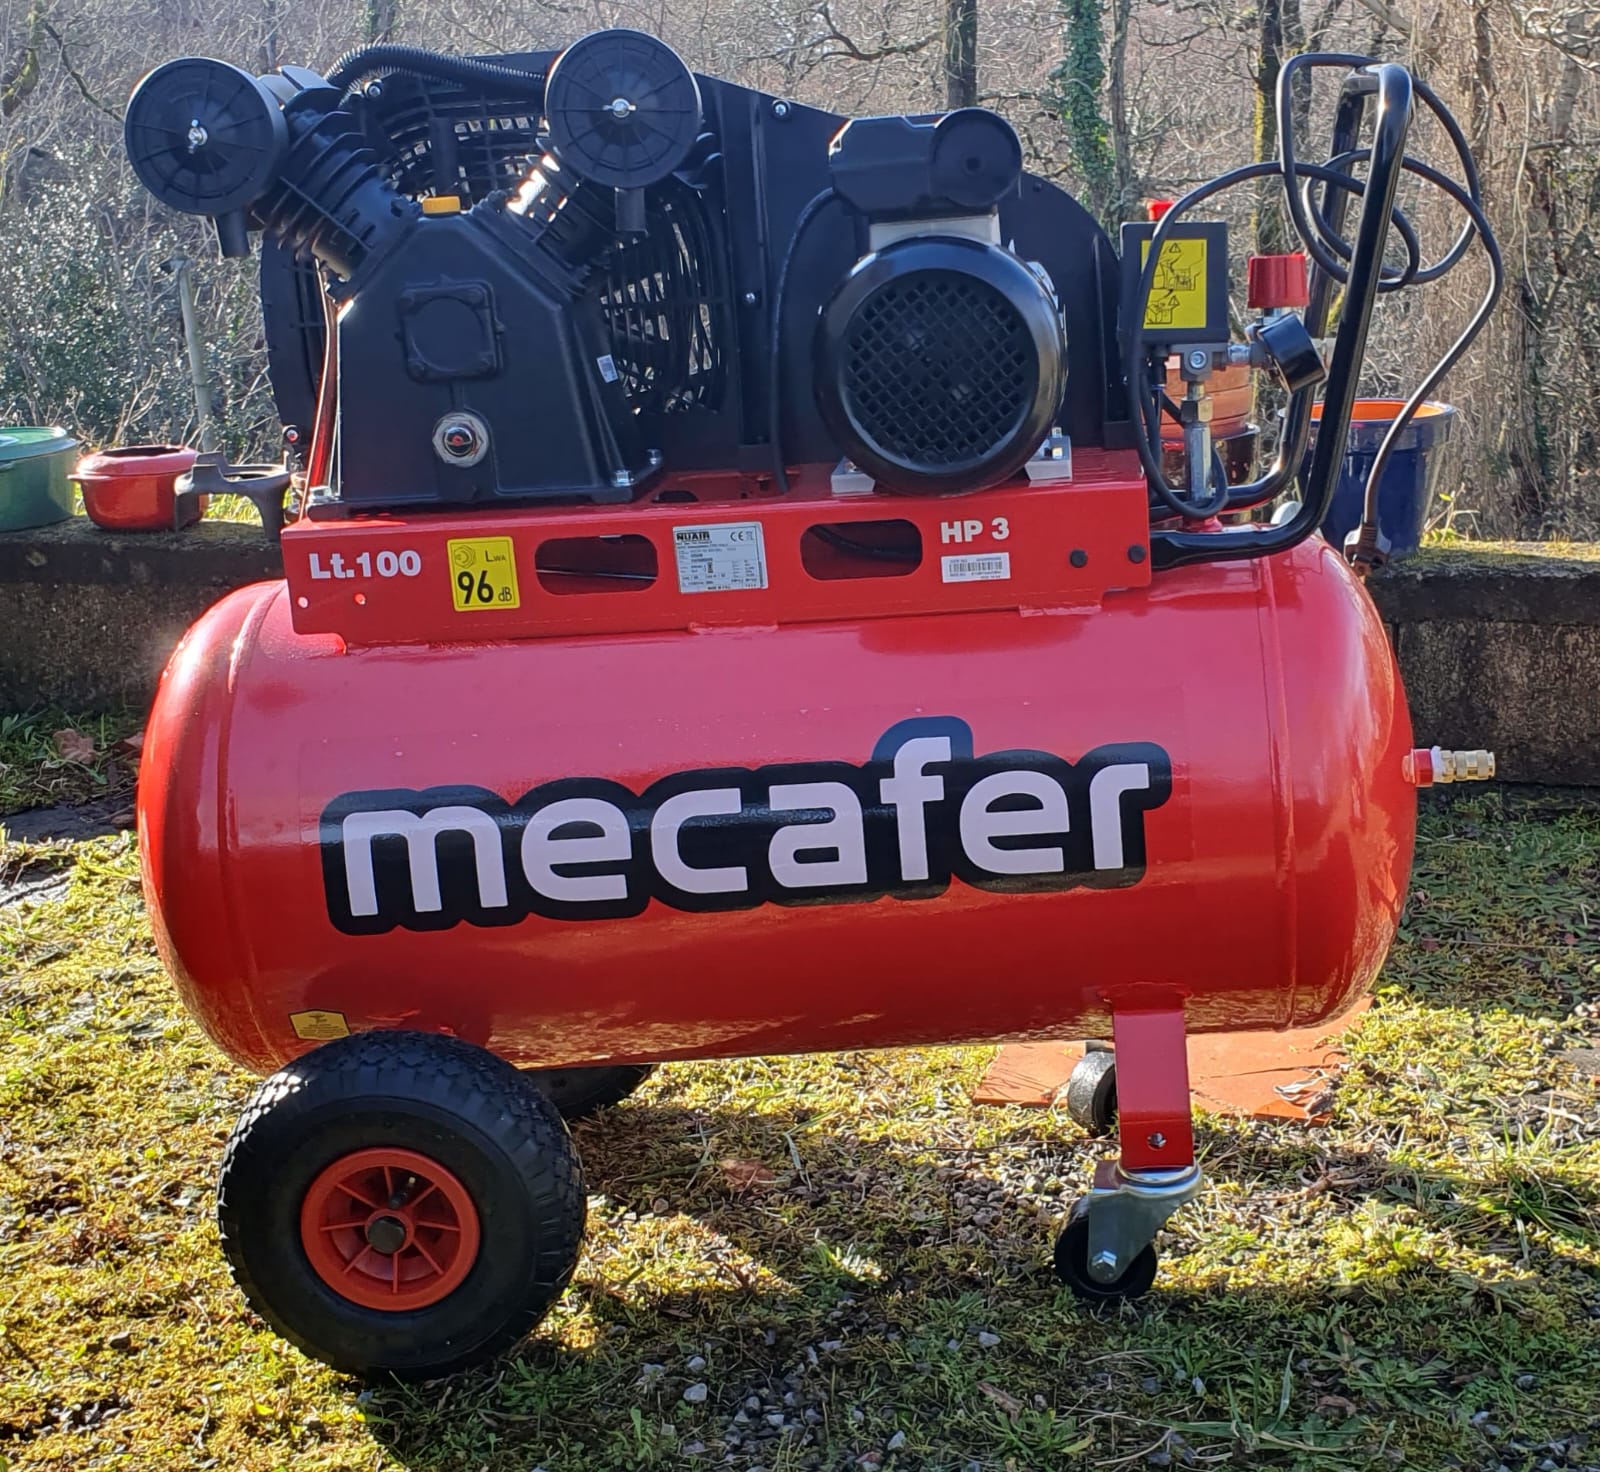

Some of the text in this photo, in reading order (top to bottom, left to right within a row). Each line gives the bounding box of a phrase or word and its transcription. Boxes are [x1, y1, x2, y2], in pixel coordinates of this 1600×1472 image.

[940, 516, 1010, 544] HP 3
[308, 549, 422, 579] Lt.100
[457, 570, 512, 604] 96 dB
[340, 735, 1150, 918] mecafer
